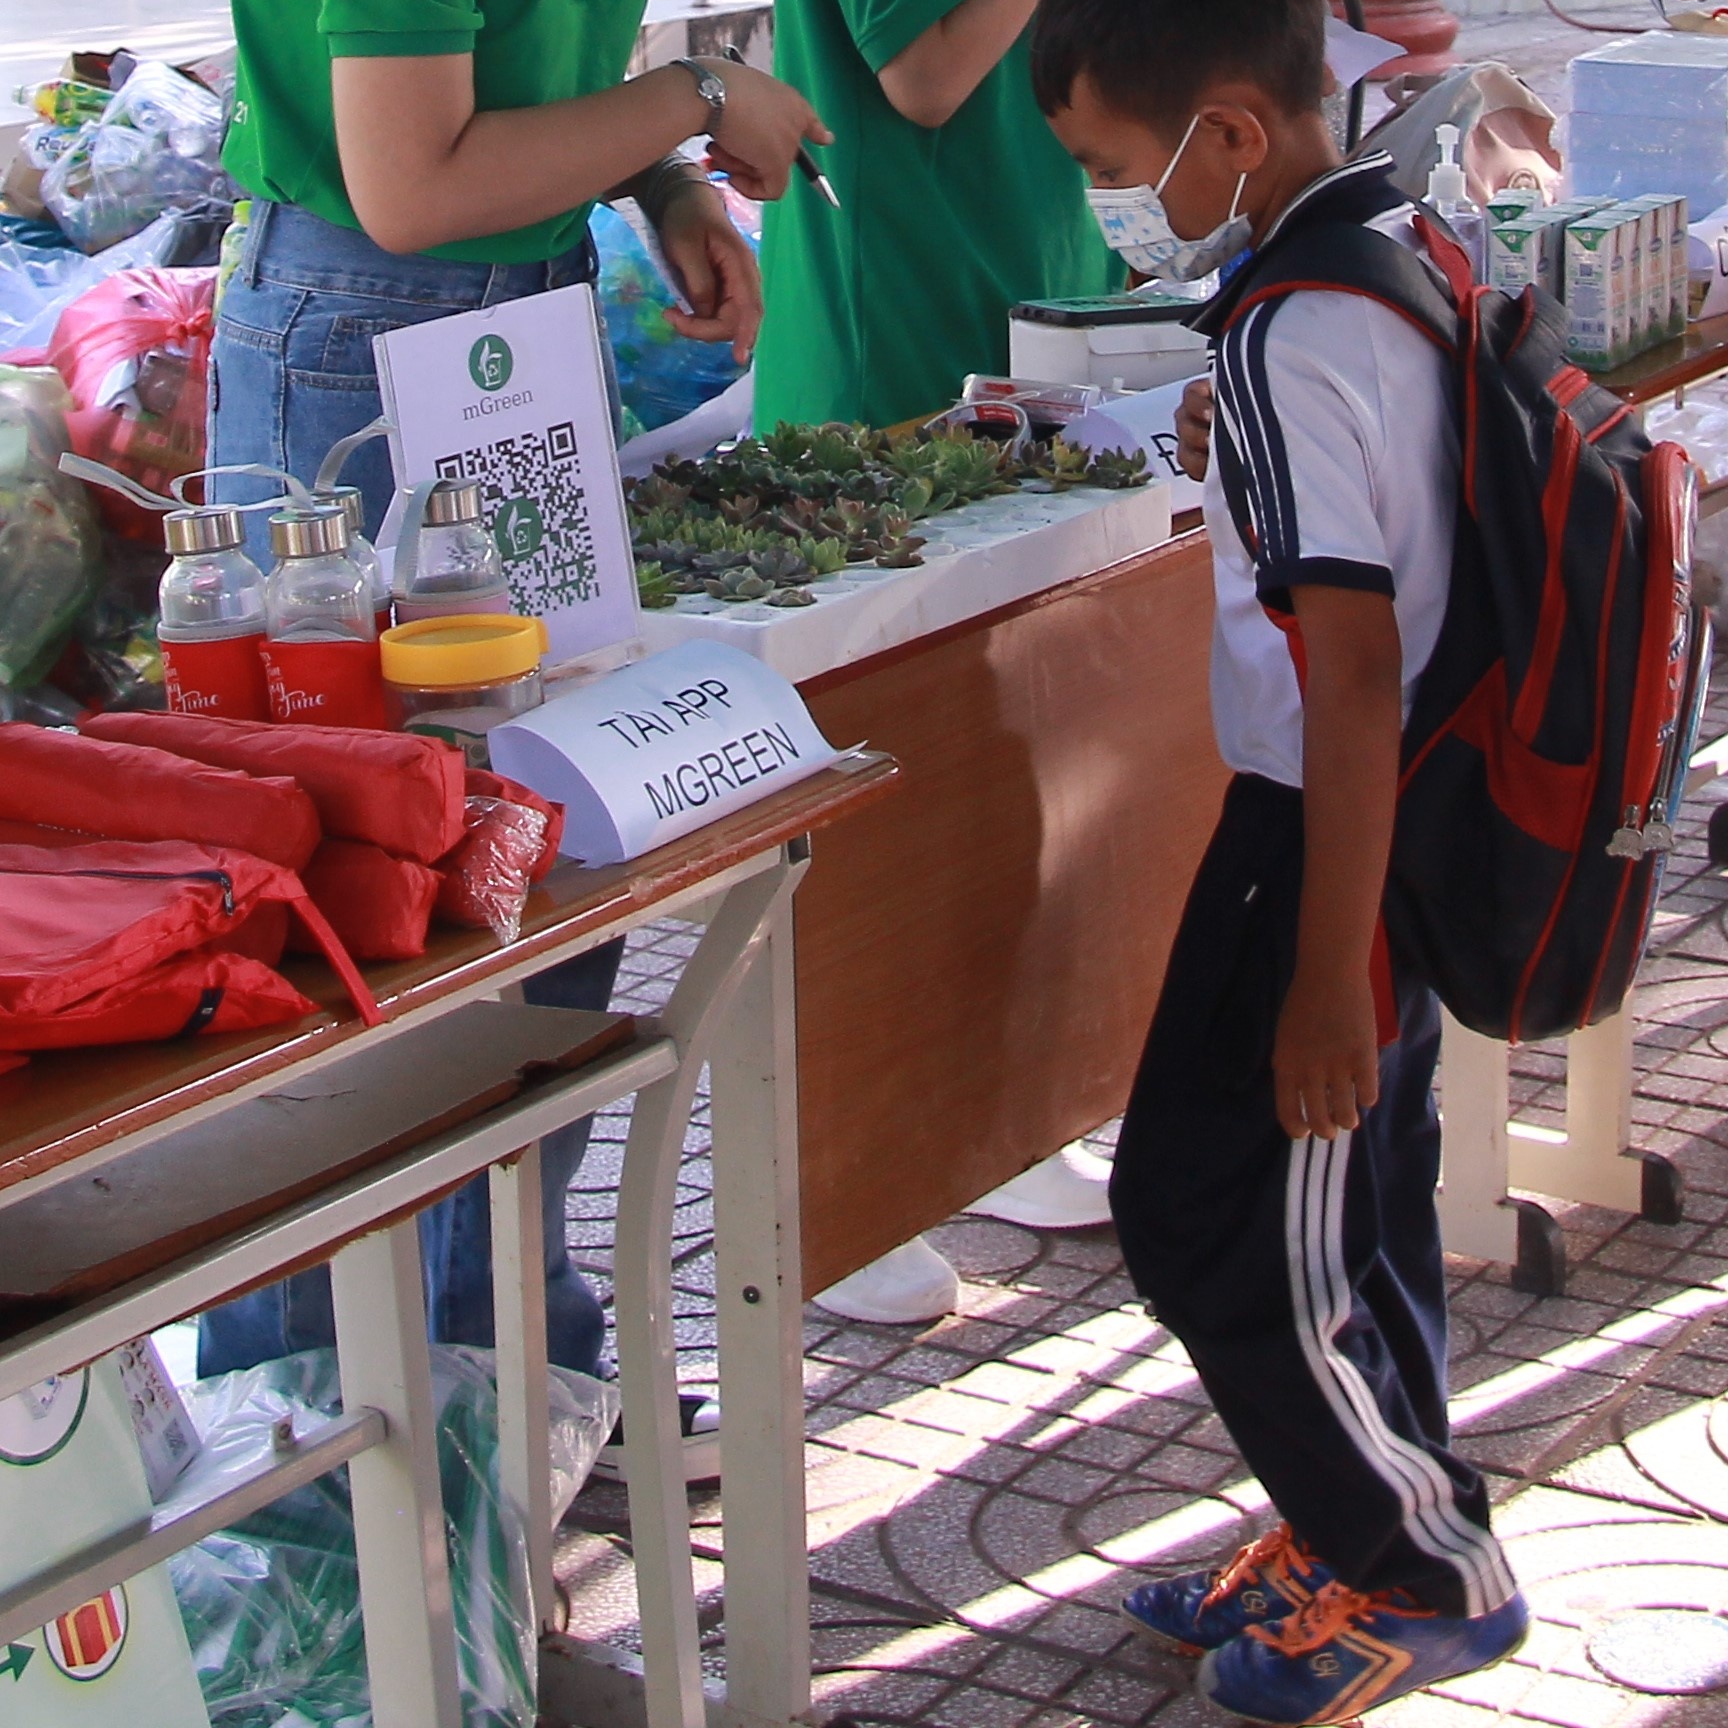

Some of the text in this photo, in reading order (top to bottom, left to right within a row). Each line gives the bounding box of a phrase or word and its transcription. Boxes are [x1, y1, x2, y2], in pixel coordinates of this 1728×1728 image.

[462, 389, 534, 420] mGreen
[662, 679, 732, 726] APP
[643, 721, 800, 820] MGREEN
